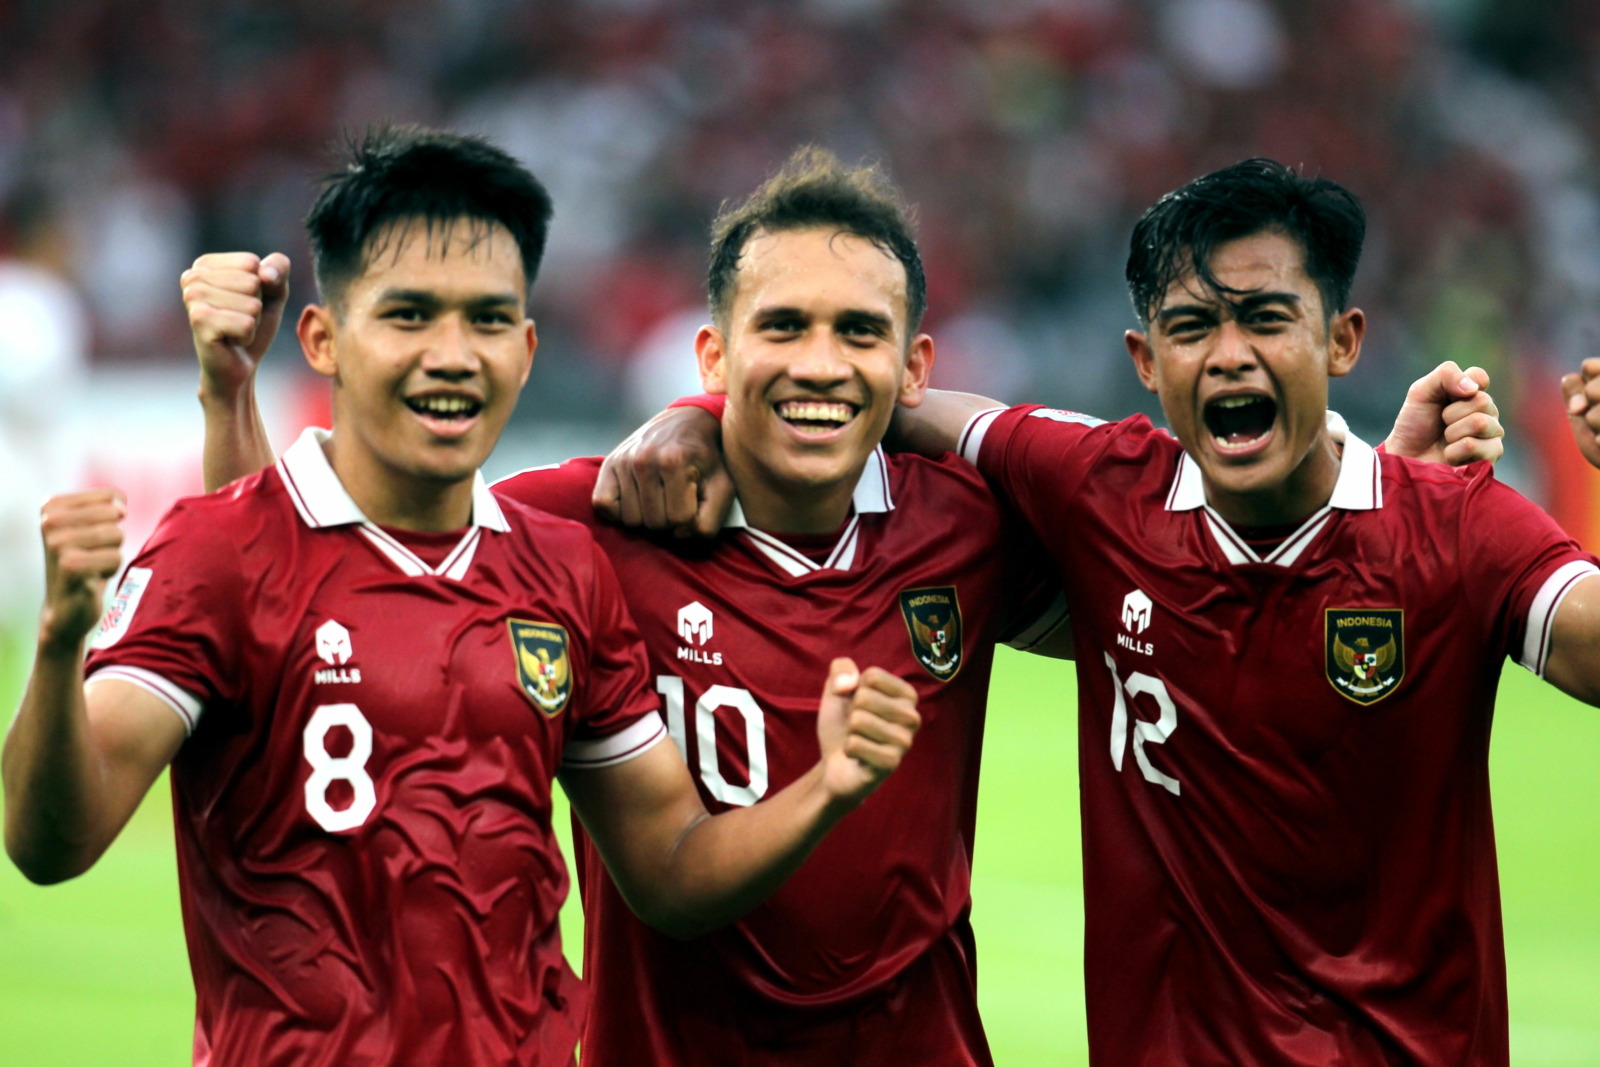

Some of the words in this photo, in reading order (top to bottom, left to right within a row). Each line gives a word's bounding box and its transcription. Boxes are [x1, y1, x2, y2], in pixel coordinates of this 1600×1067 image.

[908, 595, 950, 607] INDONESIA
[1336, 616, 1393, 628] INDONESIA
[1117, 633, 1154, 656] MILLS
[677, 646, 723, 666] MILLS
[315, 668, 361, 685] MILLS
[1104, 650, 1181, 797] 12
[656, 675, 769, 807] 10
[303, 703, 377, 832] 8
